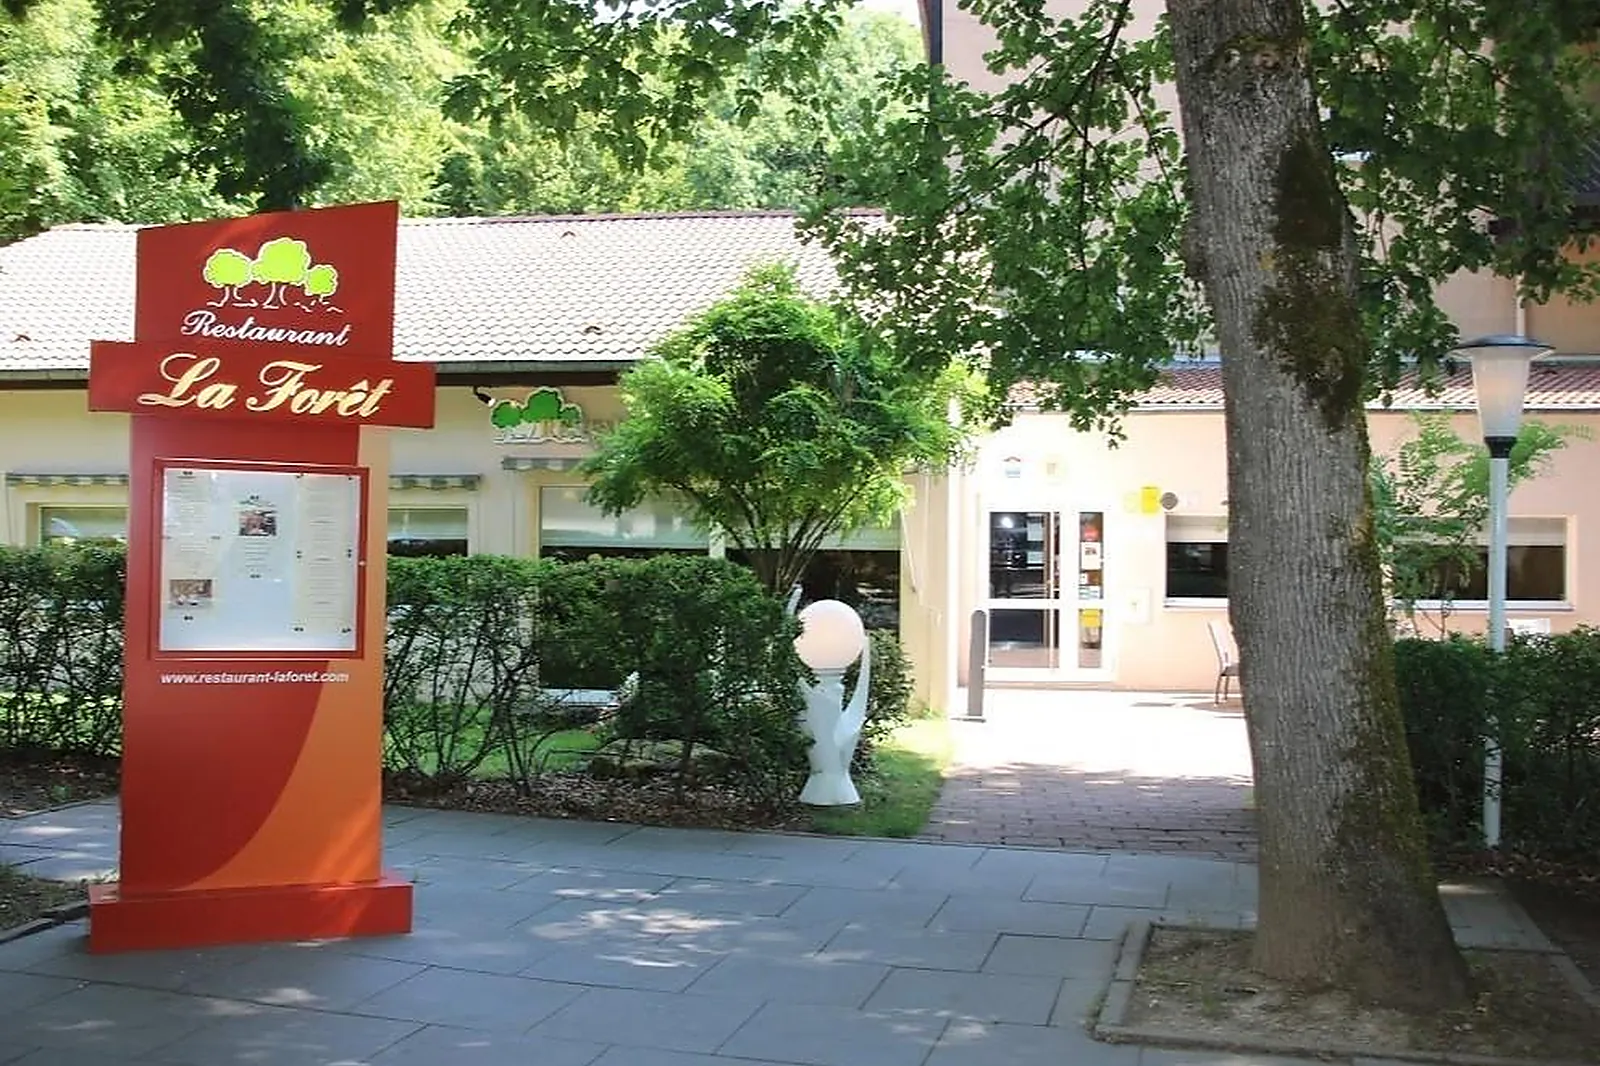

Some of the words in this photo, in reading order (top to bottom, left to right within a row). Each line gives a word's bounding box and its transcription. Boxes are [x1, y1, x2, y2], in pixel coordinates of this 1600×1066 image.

[180, 309, 351, 347] Restaurant
[137, 352, 237, 408] La
[246, 360, 393, 418] Forêt
[159, 671, 350, 684] www.restaurant-laforet.com
